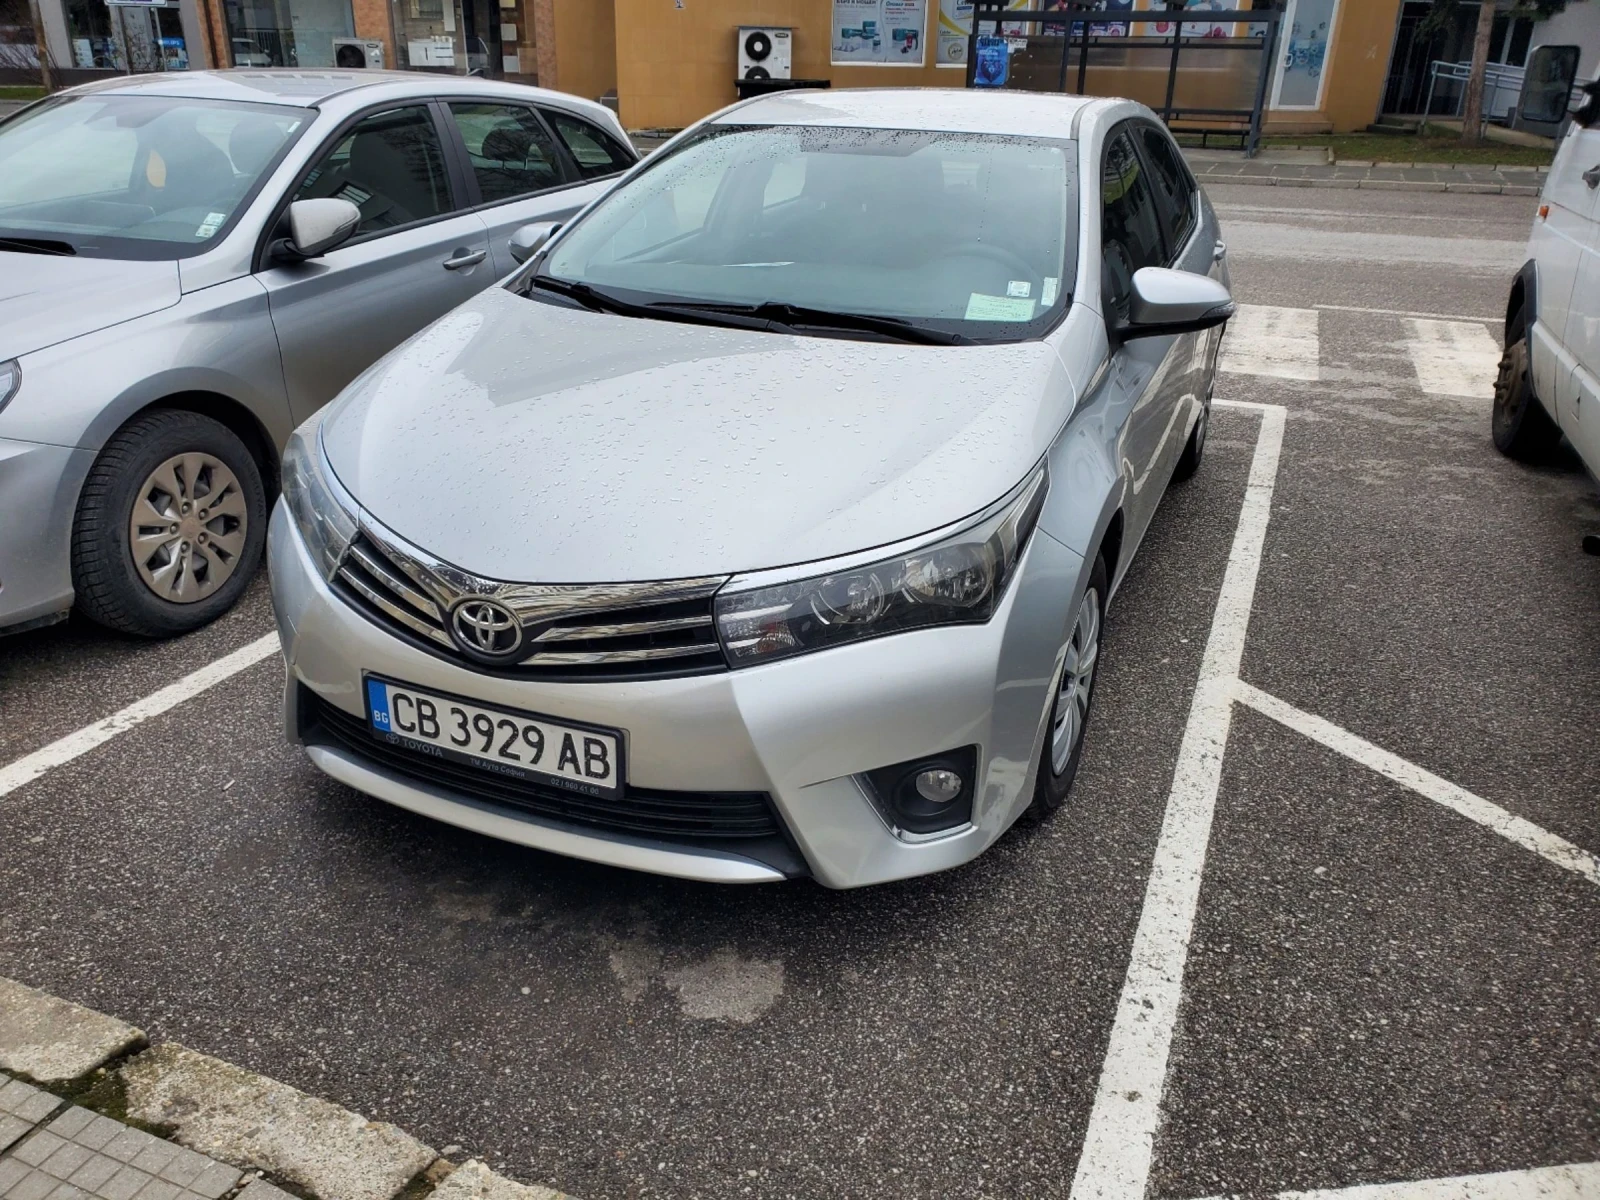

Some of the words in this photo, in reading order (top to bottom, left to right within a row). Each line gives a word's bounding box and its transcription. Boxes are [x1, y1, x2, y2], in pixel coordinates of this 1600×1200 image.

[373, 709, 389, 724] BG
[392, 692, 440, 739] CB
[450, 707, 545, 765] 3929
[557, 732, 611, 780] AB
[403, 739, 443, 757] TOYOTA
[501, 765, 524, 777] София
